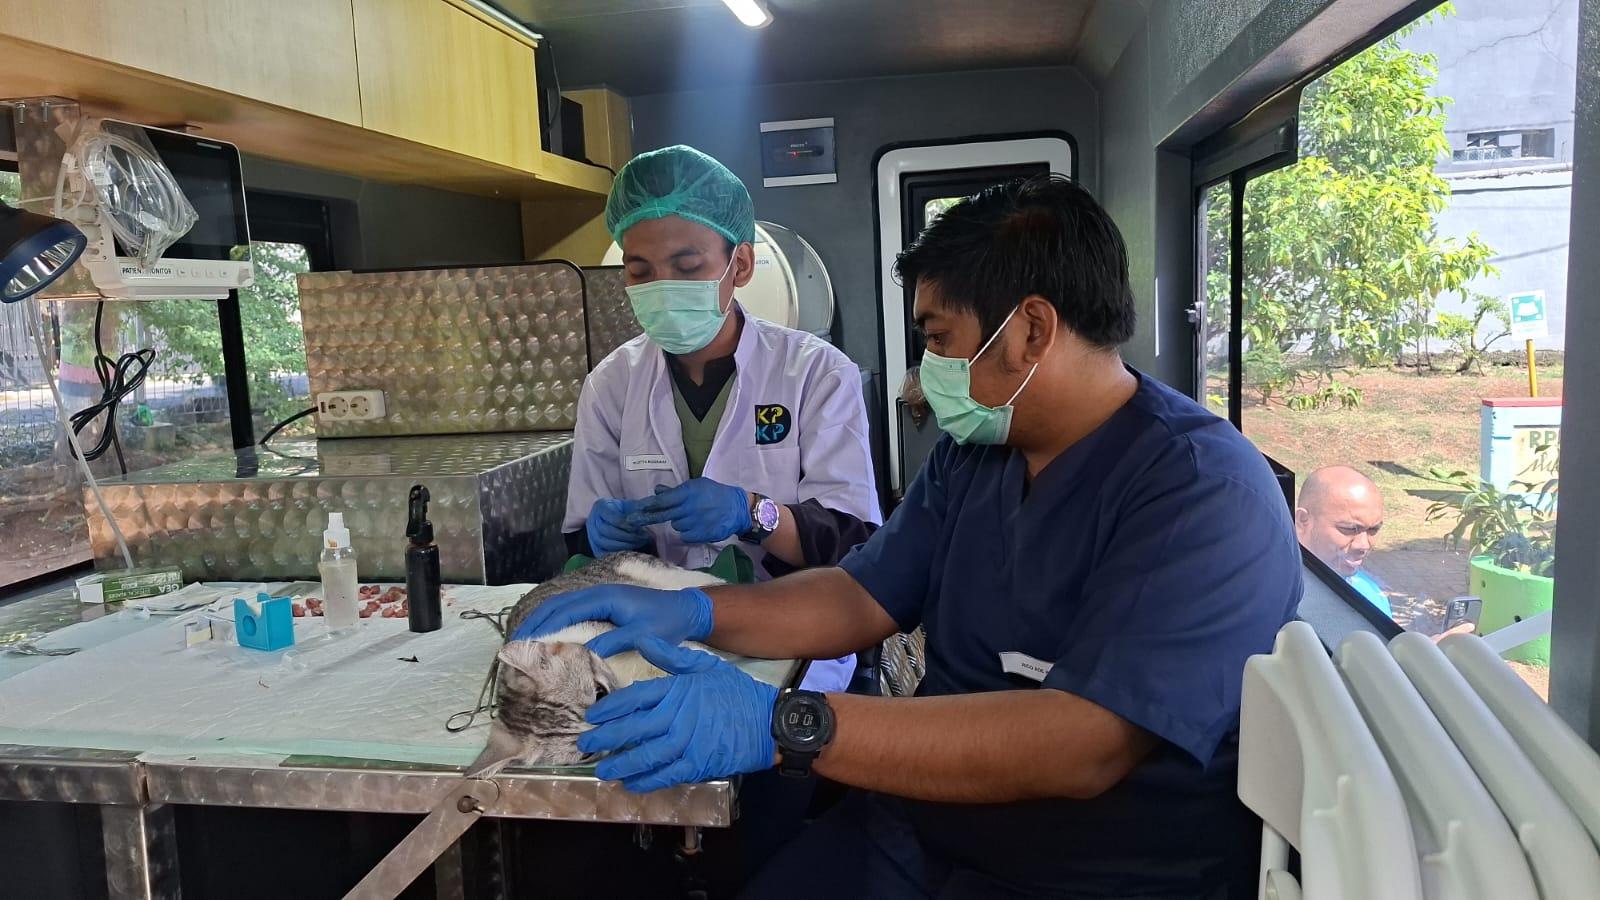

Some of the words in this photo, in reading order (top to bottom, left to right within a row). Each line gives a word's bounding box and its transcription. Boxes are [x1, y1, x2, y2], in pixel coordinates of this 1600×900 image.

[151, 267, 172, 275] ONITOR
[1529, 430, 1560, 449] RP
[158, 583, 180, 593] GEA
